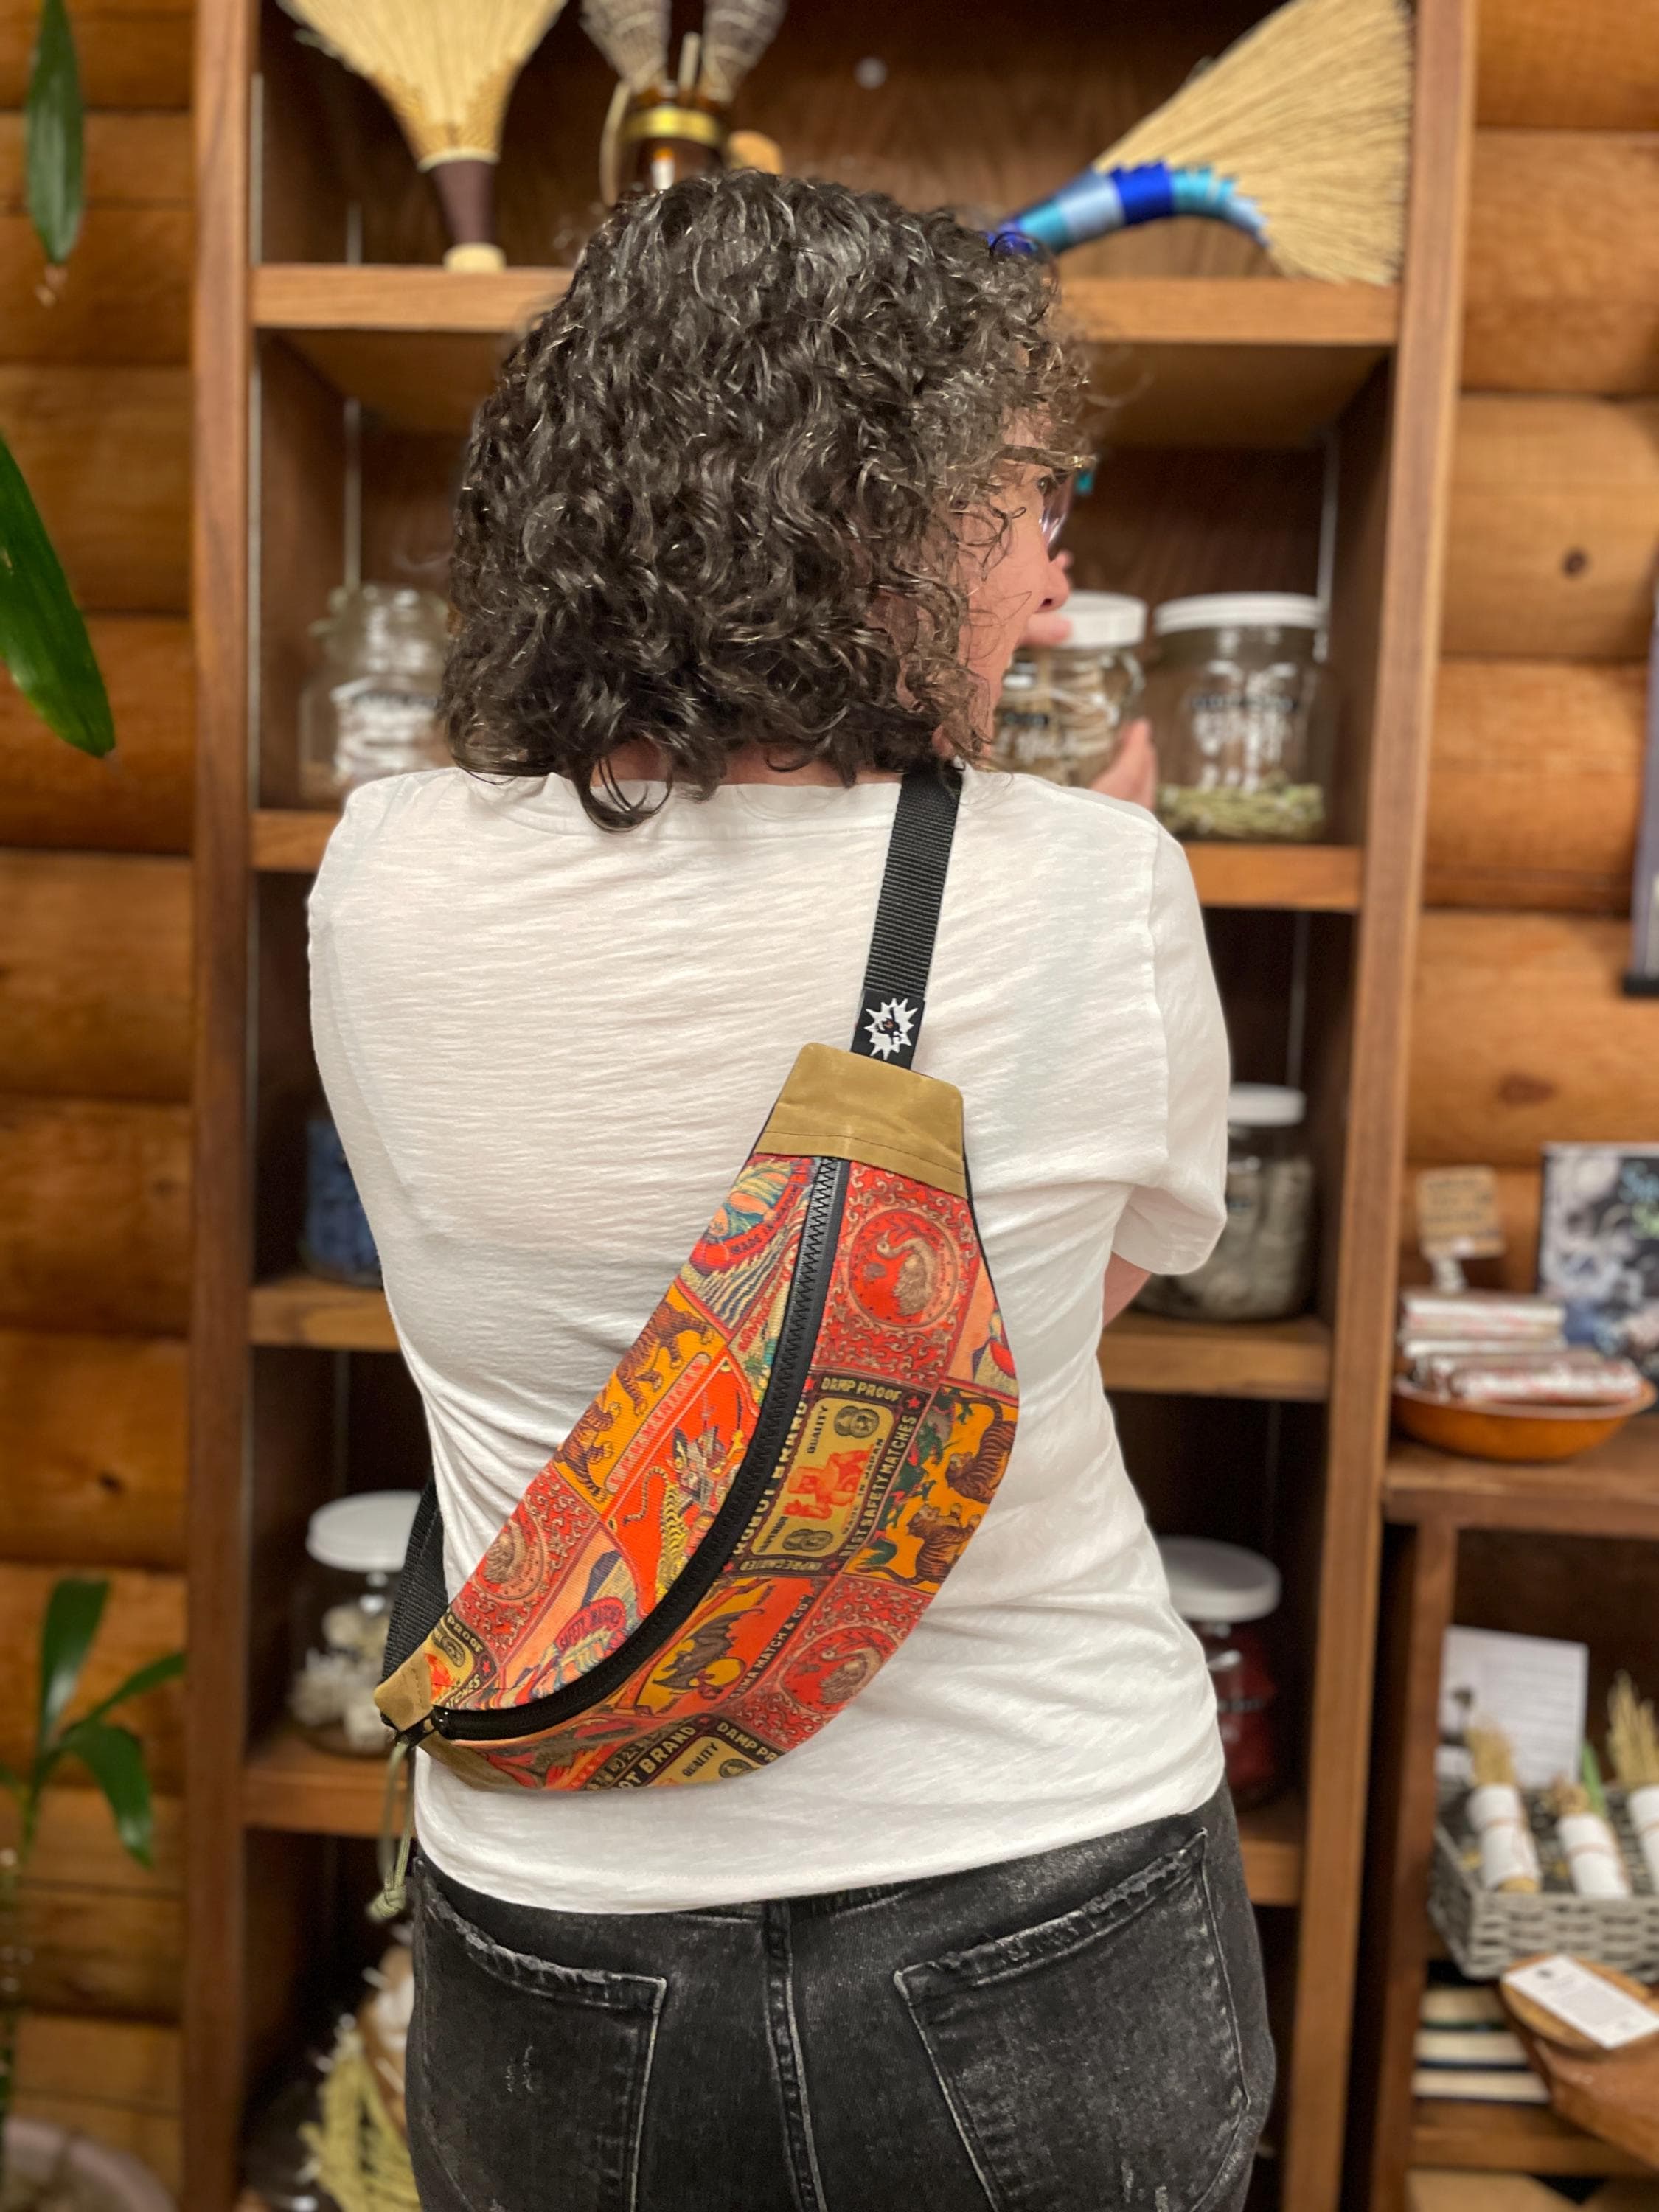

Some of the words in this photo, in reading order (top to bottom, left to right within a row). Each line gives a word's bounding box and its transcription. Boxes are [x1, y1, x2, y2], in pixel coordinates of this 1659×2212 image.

[821, 1377, 855, 1393] DAMP
[856, 1382, 902, 1401] PROOF
[807, 1405, 830, 1454] QUALITY
[860, 1474, 889, 1537] SAFETY
[882, 1415, 917, 1477] MATCHES
[446, 1613, 483, 1652] PROOF
[755, 1631, 787, 1669] MATCH
[639, 1726, 696, 1775] BRAND
[715, 1722, 758, 1749] DAMP
